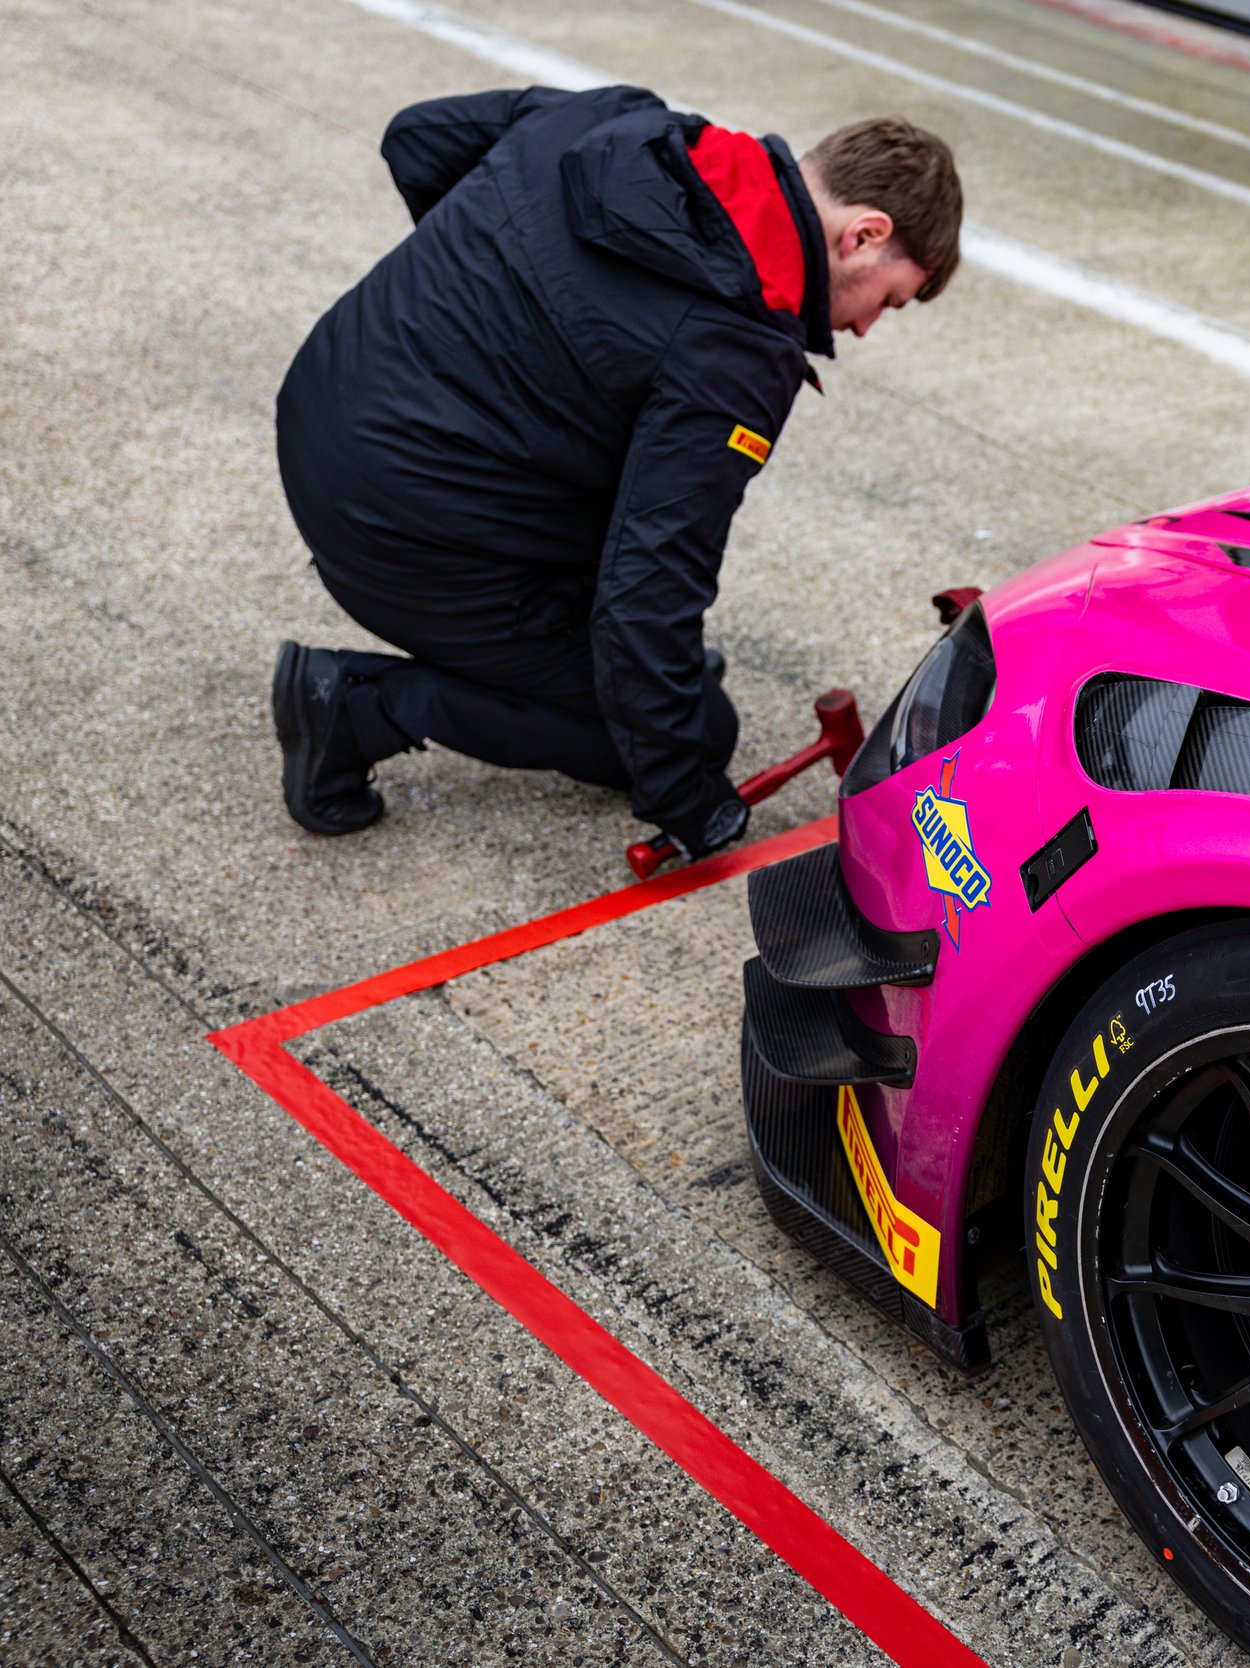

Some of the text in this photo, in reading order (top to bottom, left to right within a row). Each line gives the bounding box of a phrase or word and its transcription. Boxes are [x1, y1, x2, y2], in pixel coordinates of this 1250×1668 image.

[914, 796, 987, 904] SUNOCO
[1118, 1036, 1135, 1055] FSC
[842, 1085, 921, 1277] PIRELLI
[1036, 1033, 1111, 1321] PIRELLI
